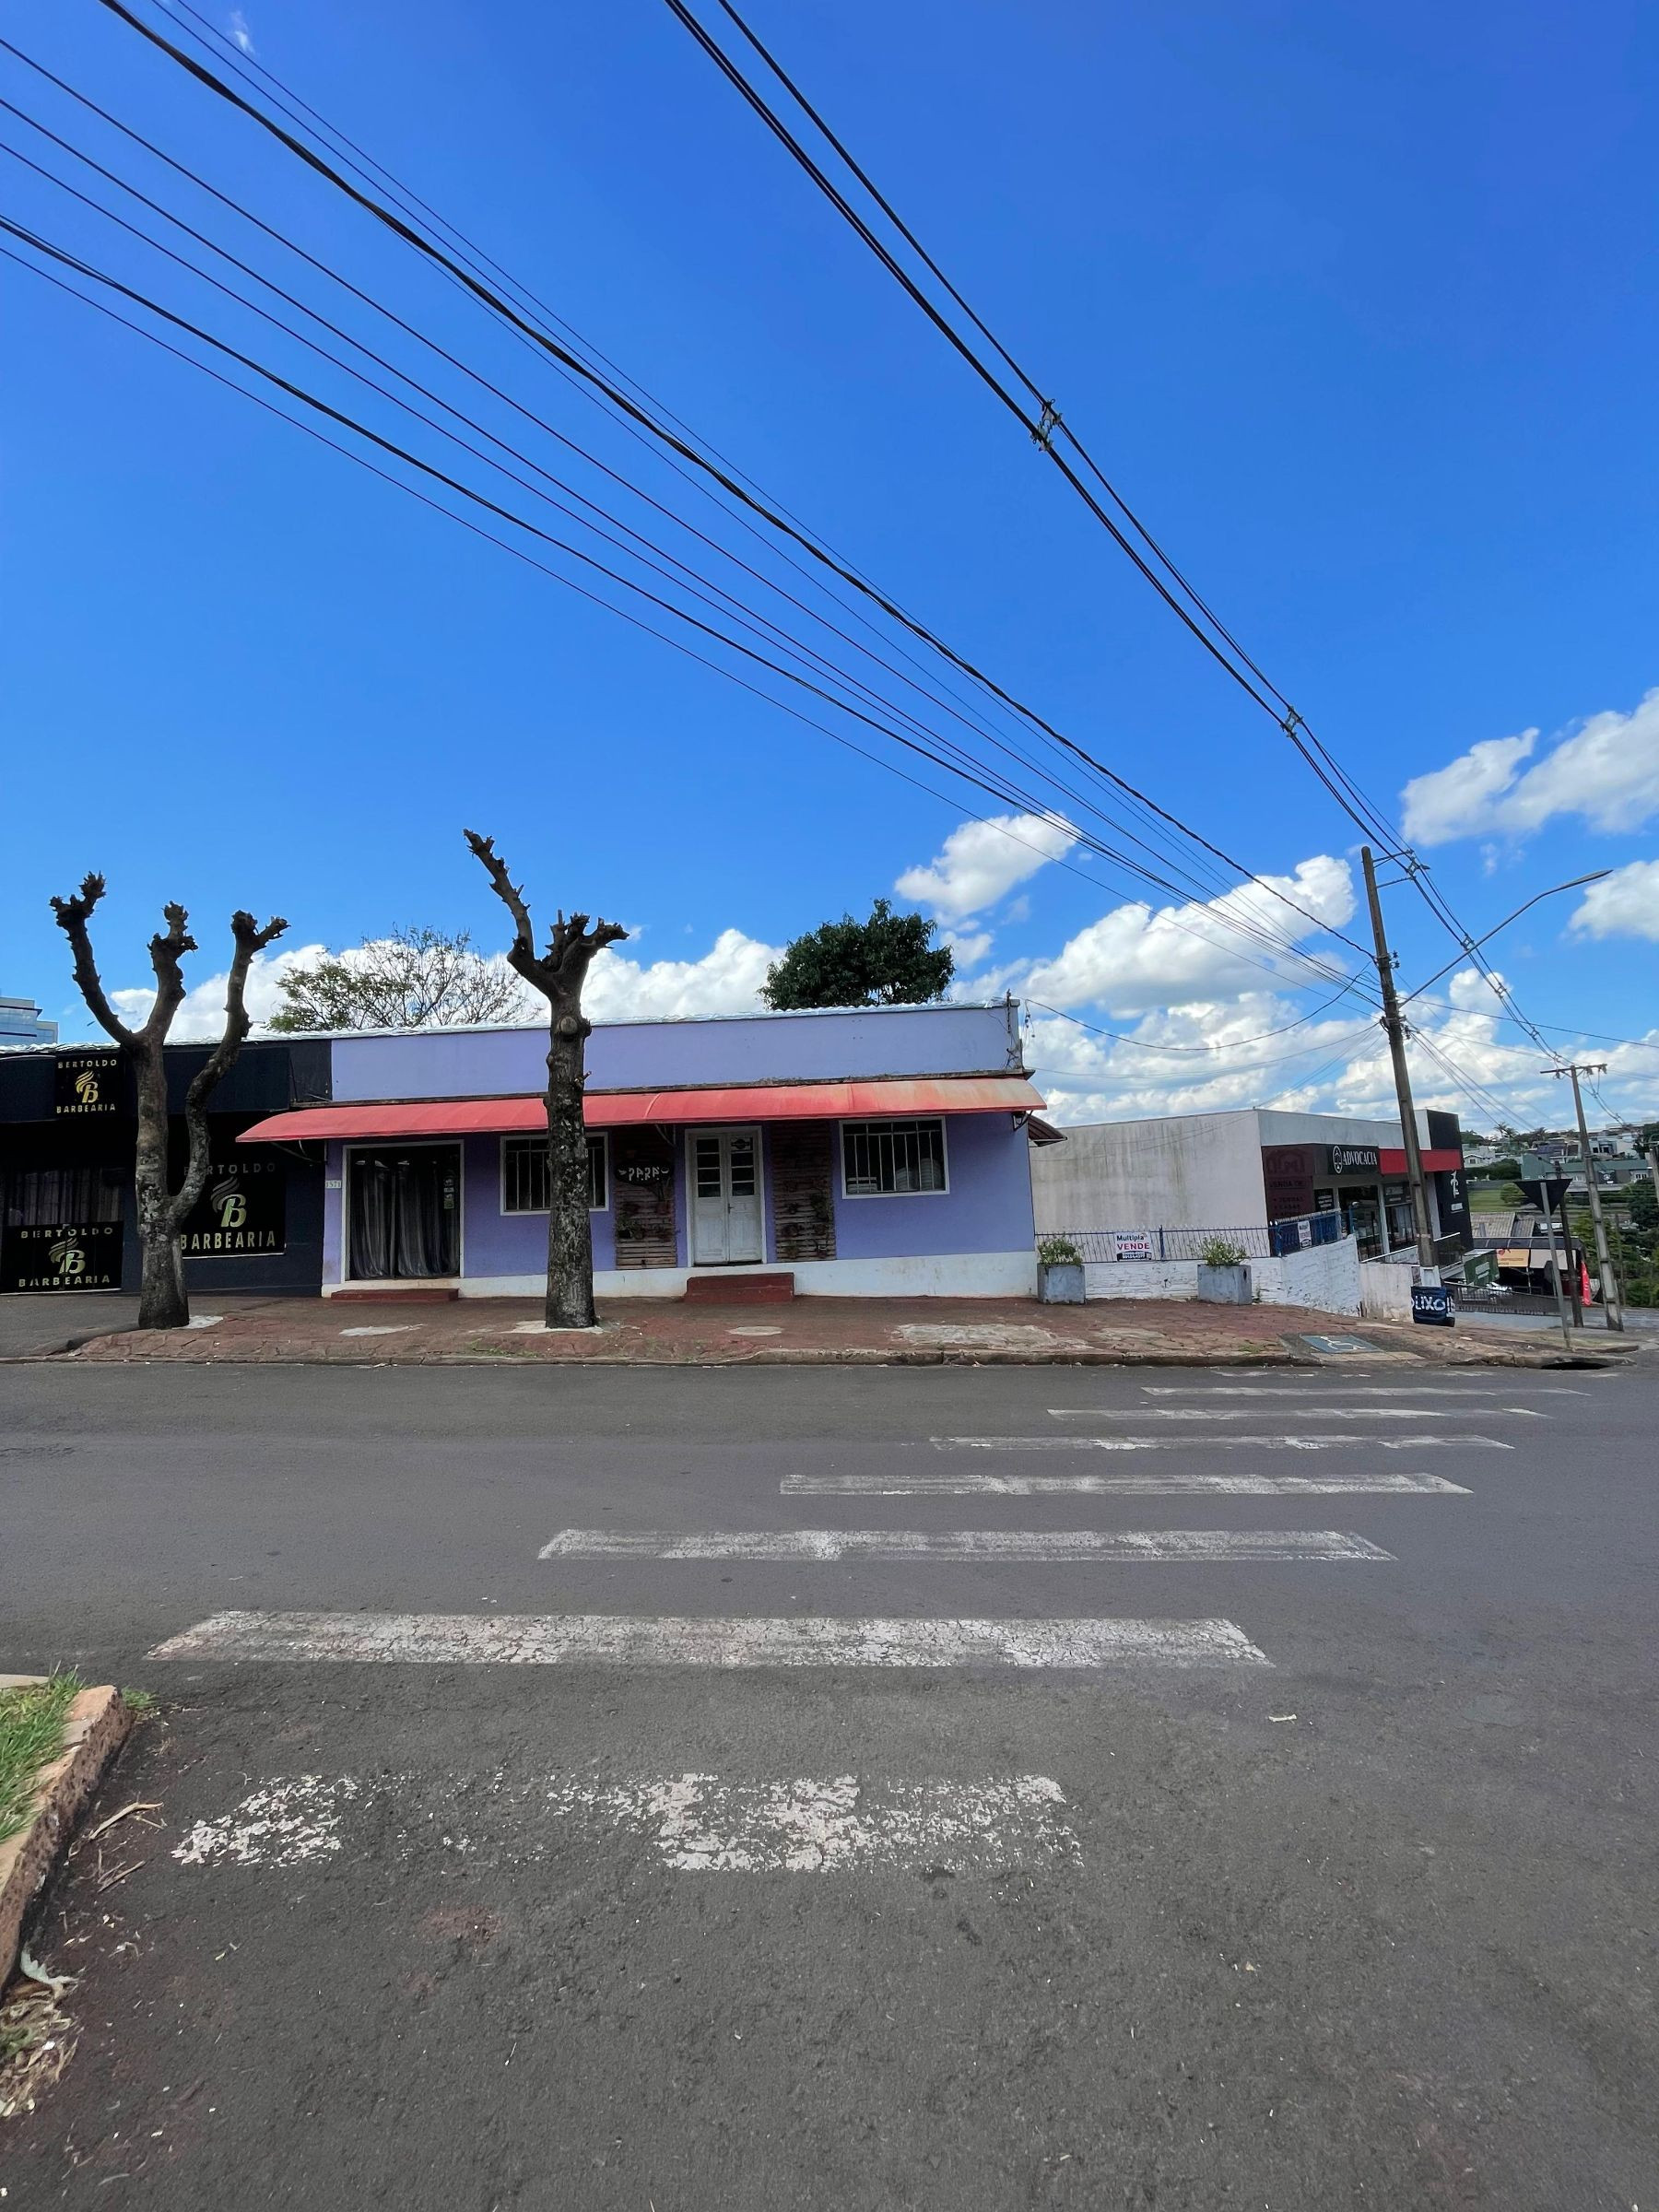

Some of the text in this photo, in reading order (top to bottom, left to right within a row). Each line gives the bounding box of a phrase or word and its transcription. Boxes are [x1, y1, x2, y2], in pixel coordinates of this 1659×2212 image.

[57, 1059, 117, 1069] BERTOLDO
[56, 1103, 116, 1113] BARBEARIA
[1343, 1151, 1377, 1165] ADVOCACIA
[20, 1227, 113, 1239] BERTOLDO
[1116, 1234, 1145, 1242] Multipla
[180, 1230, 276, 1250] BARBEARIA
[18, 1275, 111, 1287] BARBEARIA
[1415, 1295, 1446, 1312] LIXO
